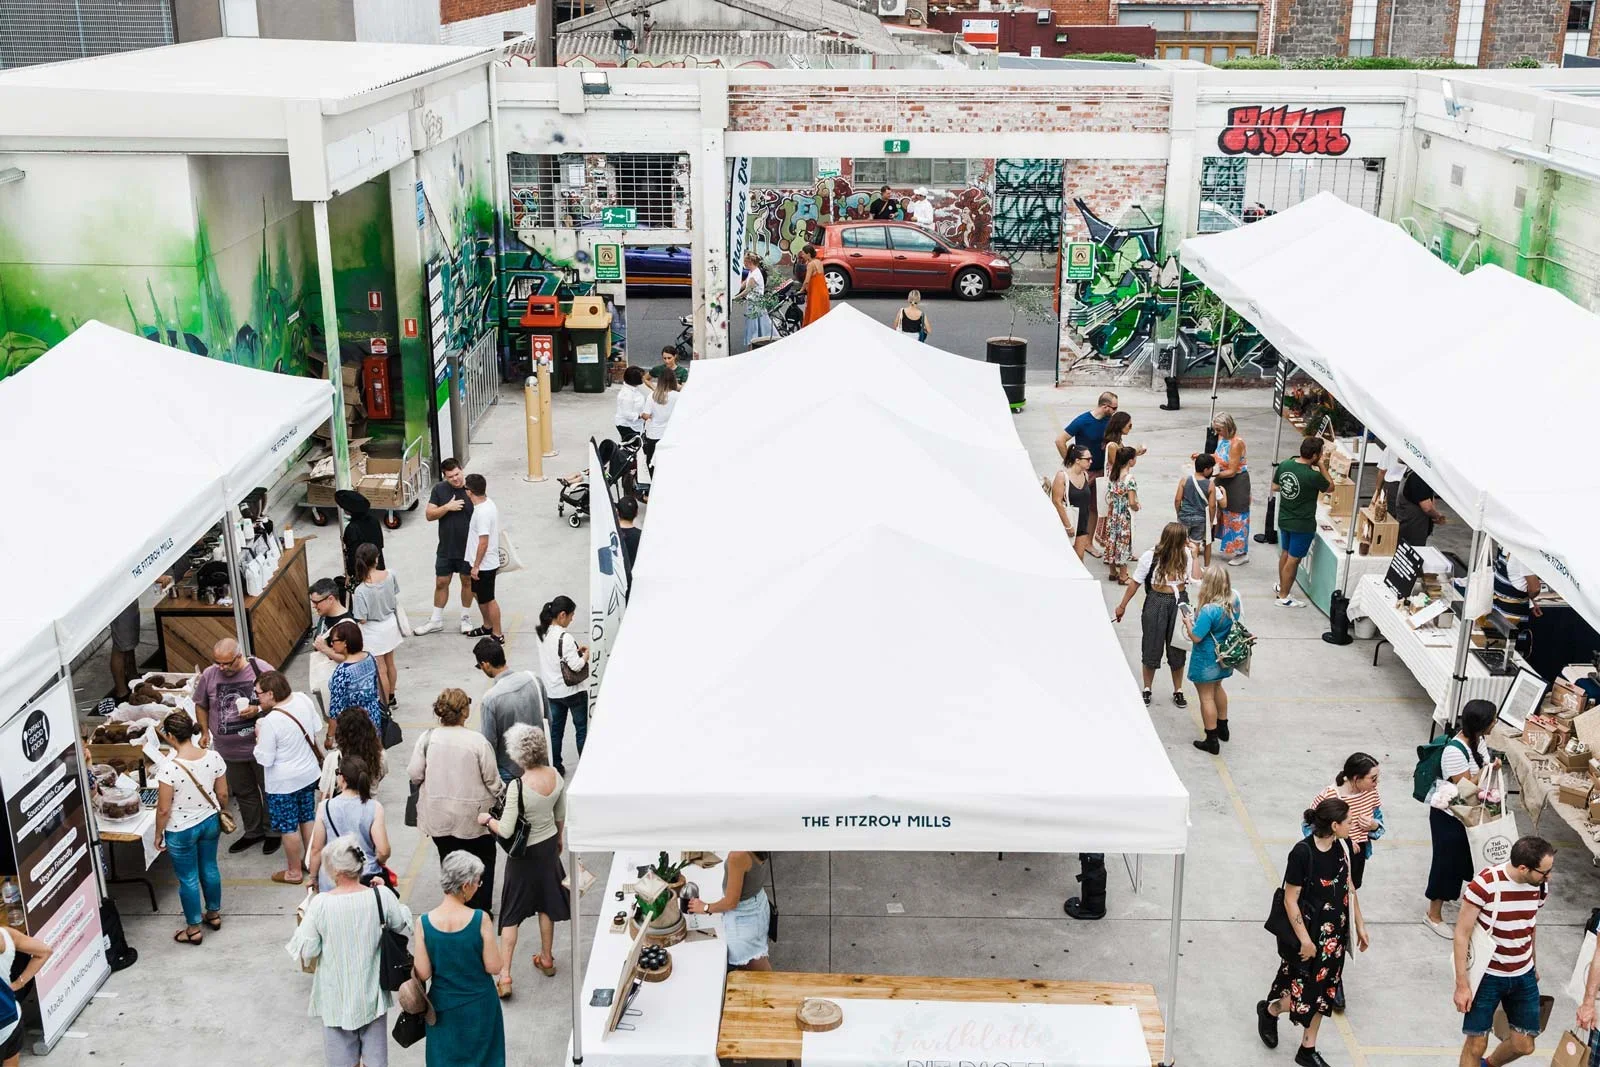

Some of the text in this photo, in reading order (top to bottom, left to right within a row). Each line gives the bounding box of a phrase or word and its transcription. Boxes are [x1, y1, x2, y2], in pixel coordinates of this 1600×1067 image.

[732, 191, 747, 275] Market
[132, 537, 174, 578] THE FITZROY MILLS
[29, 728, 44, 745] GOOD
[31, 738, 45, 753] FOOD
[54, 781, 65, 794] Care
[801, 815, 952, 828] THE FITZROY MILLS
[1487, 844, 1509, 853] FITZROY
[1491, 849, 1507, 857] MILLS
[39, 867, 55, 885] Vegan
[54, 847, 74, 870] Friendly
[46, 992, 65, 1018] Made
[70, 949, 102, 989] Melbourne
